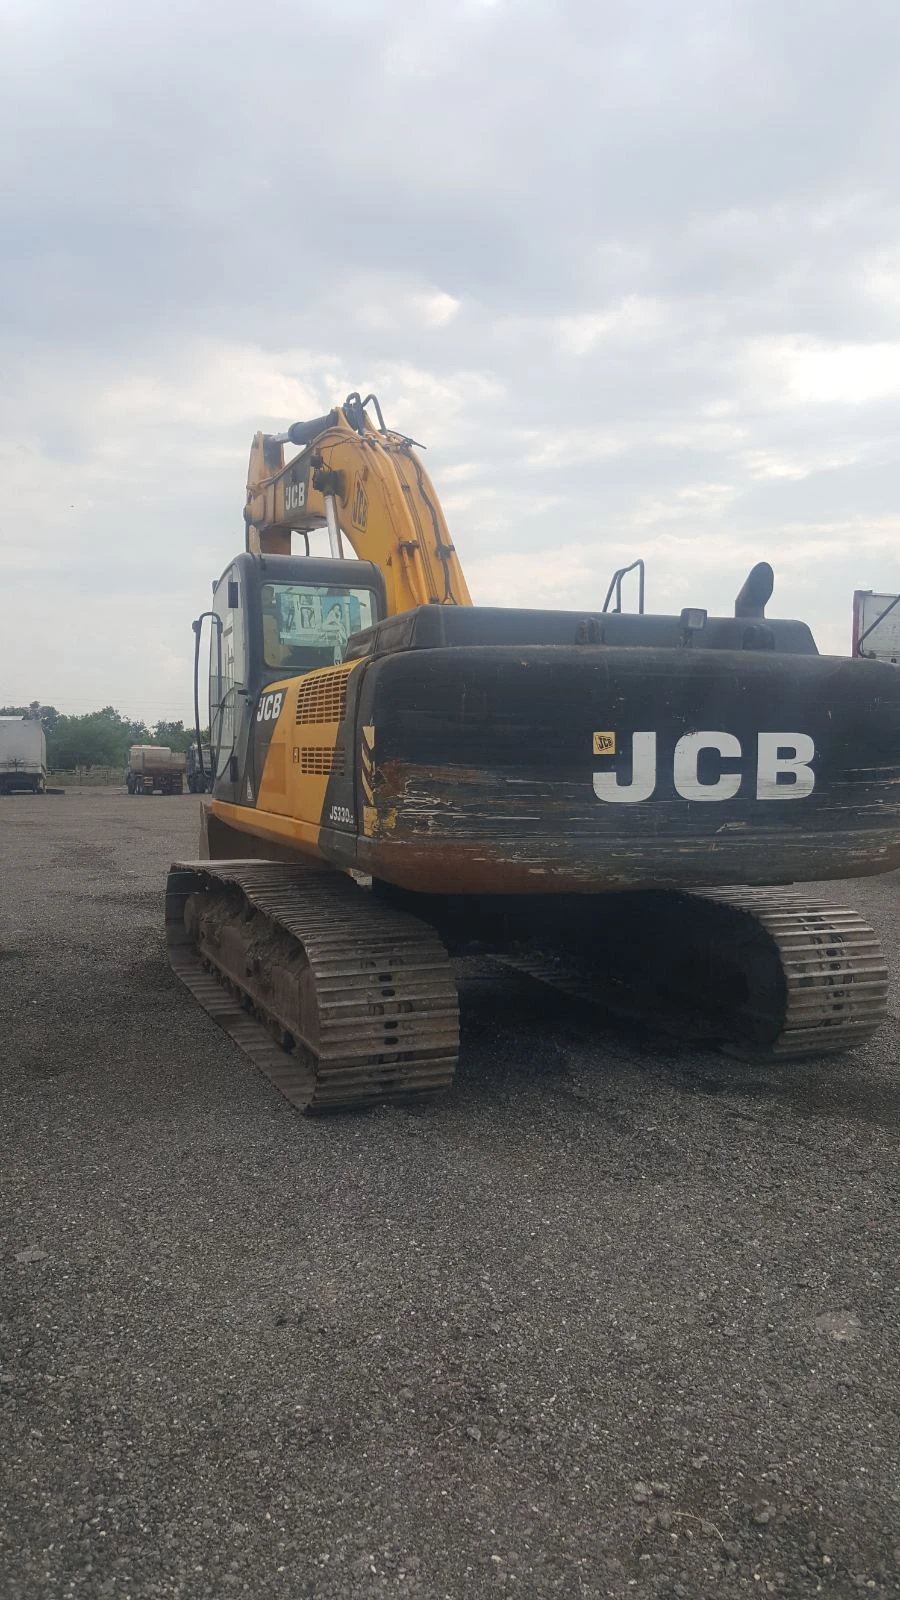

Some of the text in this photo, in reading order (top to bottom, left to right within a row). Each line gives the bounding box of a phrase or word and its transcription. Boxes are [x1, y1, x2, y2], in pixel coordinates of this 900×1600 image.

[285, 482, 305, 510] JCB
[257, 692, 283, 722] JCB
[597, 735, 614, 751] JCB
[592, 731, 815, 802] JCB
